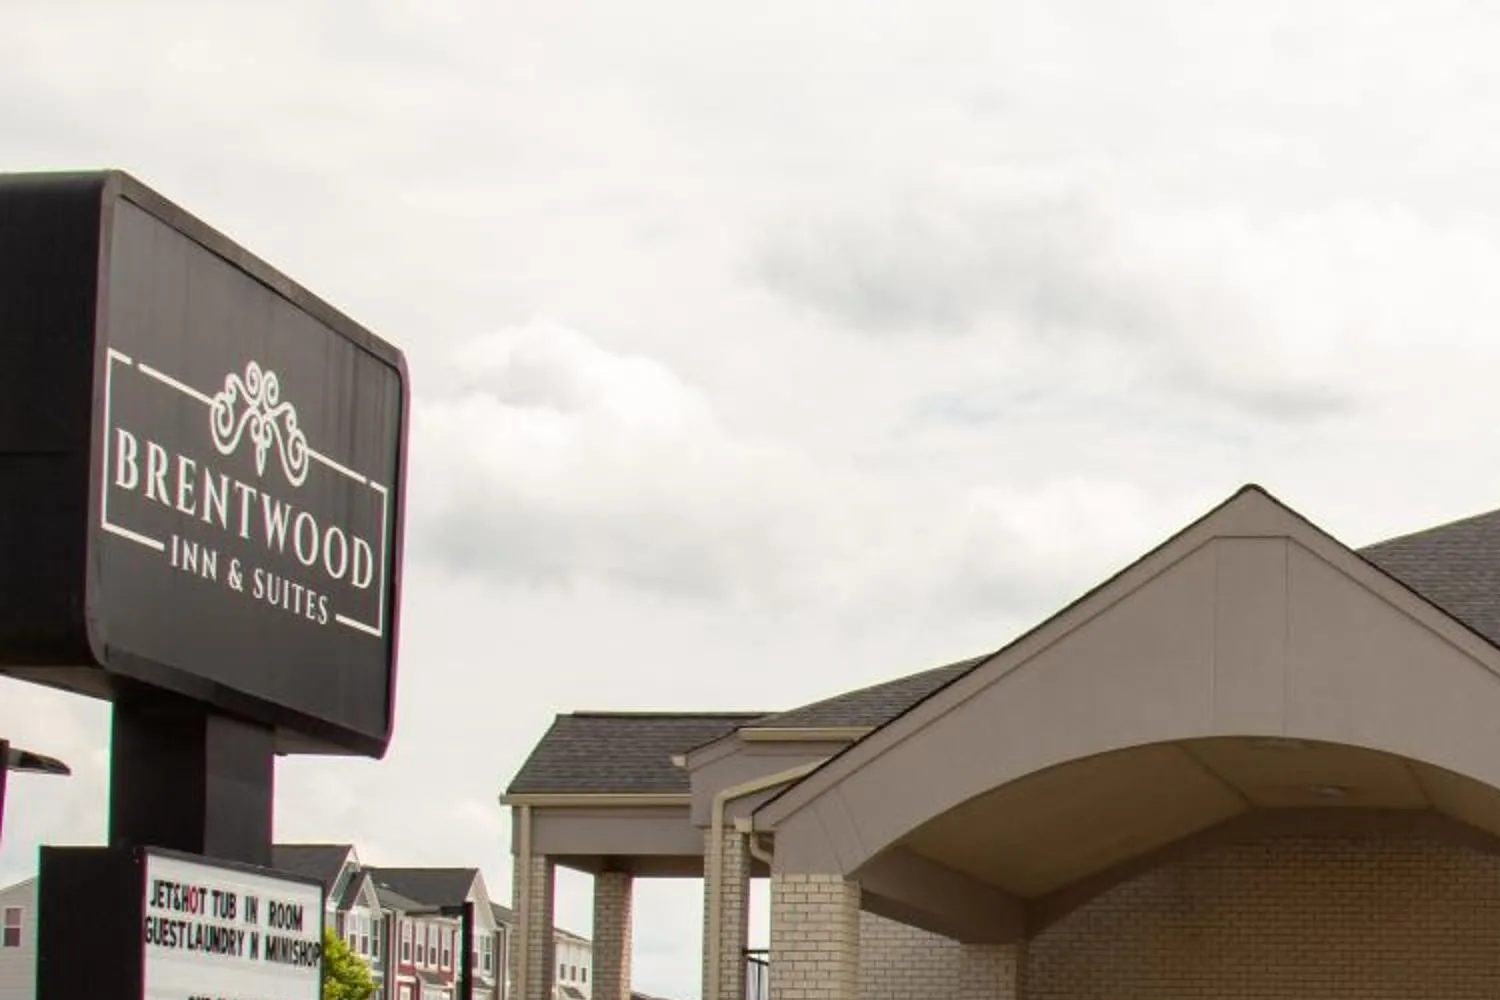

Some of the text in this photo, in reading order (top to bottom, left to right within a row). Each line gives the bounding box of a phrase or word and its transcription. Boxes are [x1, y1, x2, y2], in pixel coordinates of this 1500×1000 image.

[115, 428, 374, 590] BRENTWOOD
[171, 534, 328, 625] INN & SUITES
[211, 889, 237, 920] TUB
[245, 895, 258, 925] IN
[269, 901, 303, 932] ROOM
[250, 931, 259, 960] N
[265, 934, 320, 968] MINISHOP
